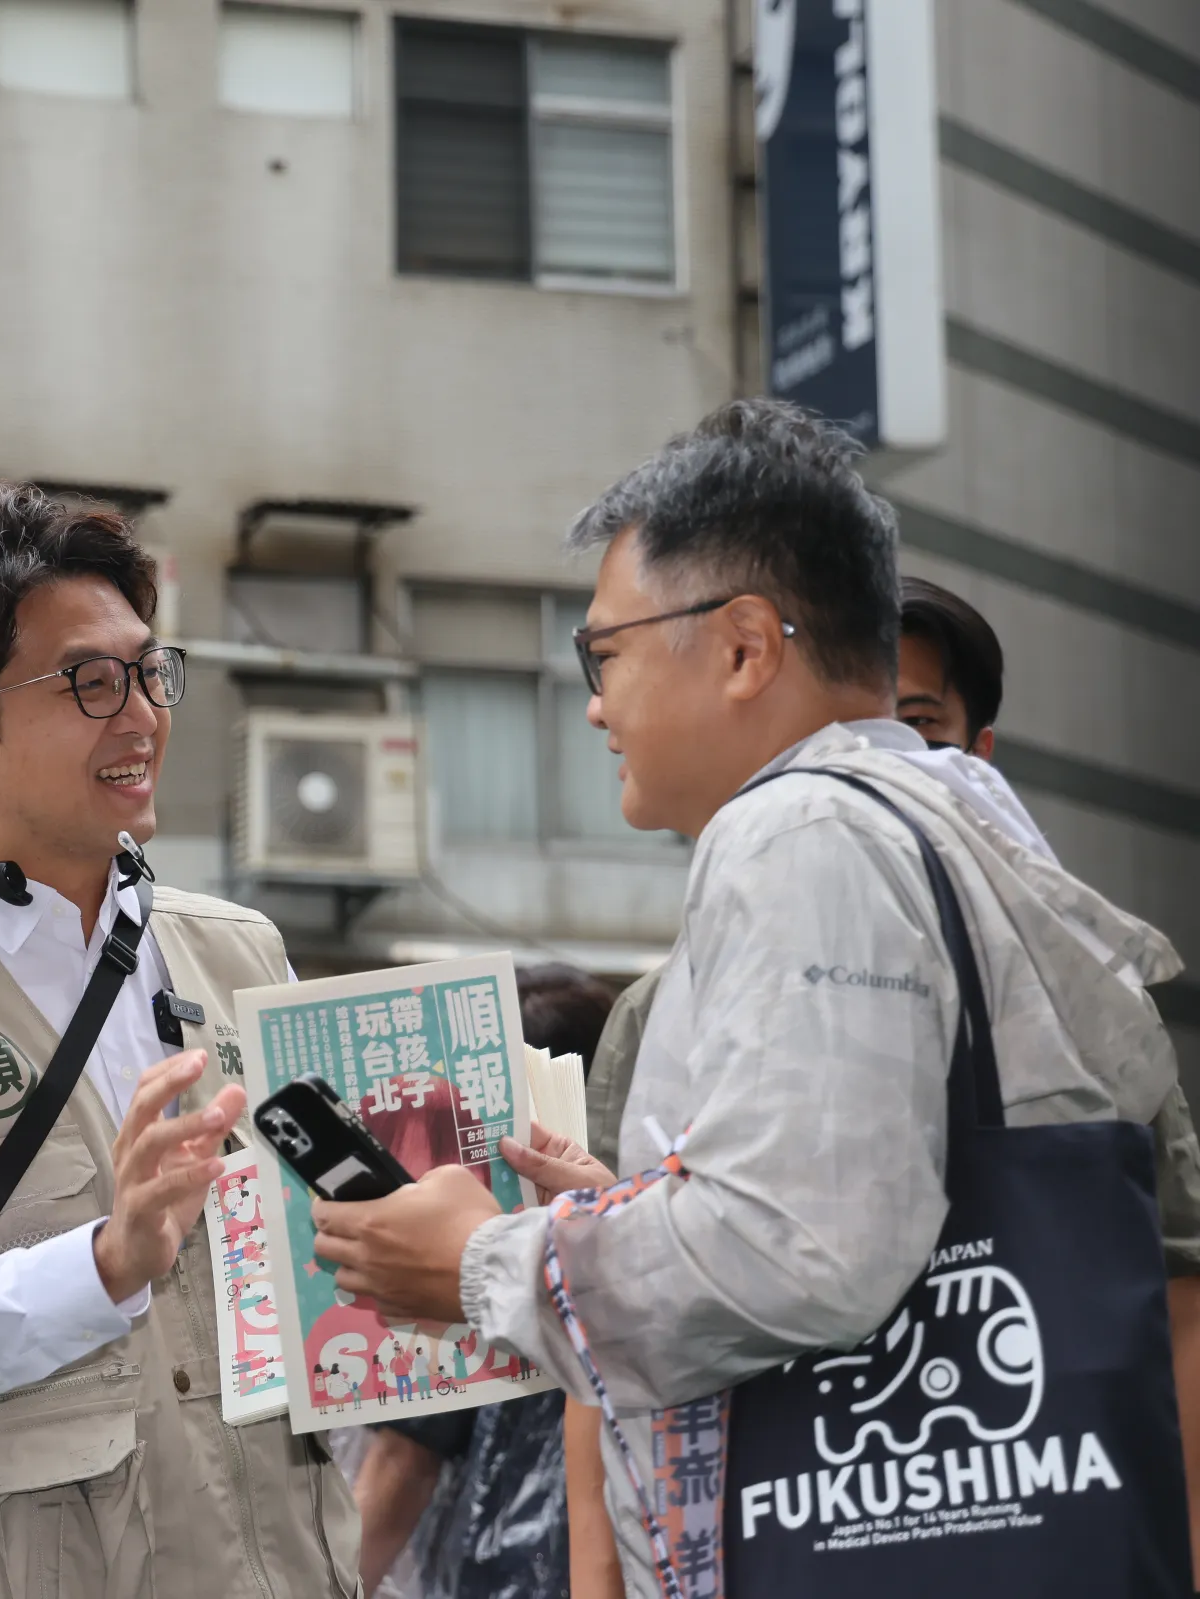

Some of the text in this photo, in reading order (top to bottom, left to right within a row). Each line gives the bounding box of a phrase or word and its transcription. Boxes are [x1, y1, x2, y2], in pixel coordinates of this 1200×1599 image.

[355, 1002, 402, 1115] 玩台北
[390, 996, 435, 1109] 帶孩子
[444, 983, 510, 1120] 順報
[929, 1238, 993, 1272] JAPAN
[741, 1432, 1122, 1539] FUKUSHIMA
[813, 1514, 1044, 1551] in Medical Device Parts Production Value
[832, 1521, 873, 1537] Japan's
[875, 1516, 900, 1530] No.1
[903, 1514, 921, 1527] for
[938, 1508, 969, 1521] Years
[971, 1502, 1022, 1516] Running
